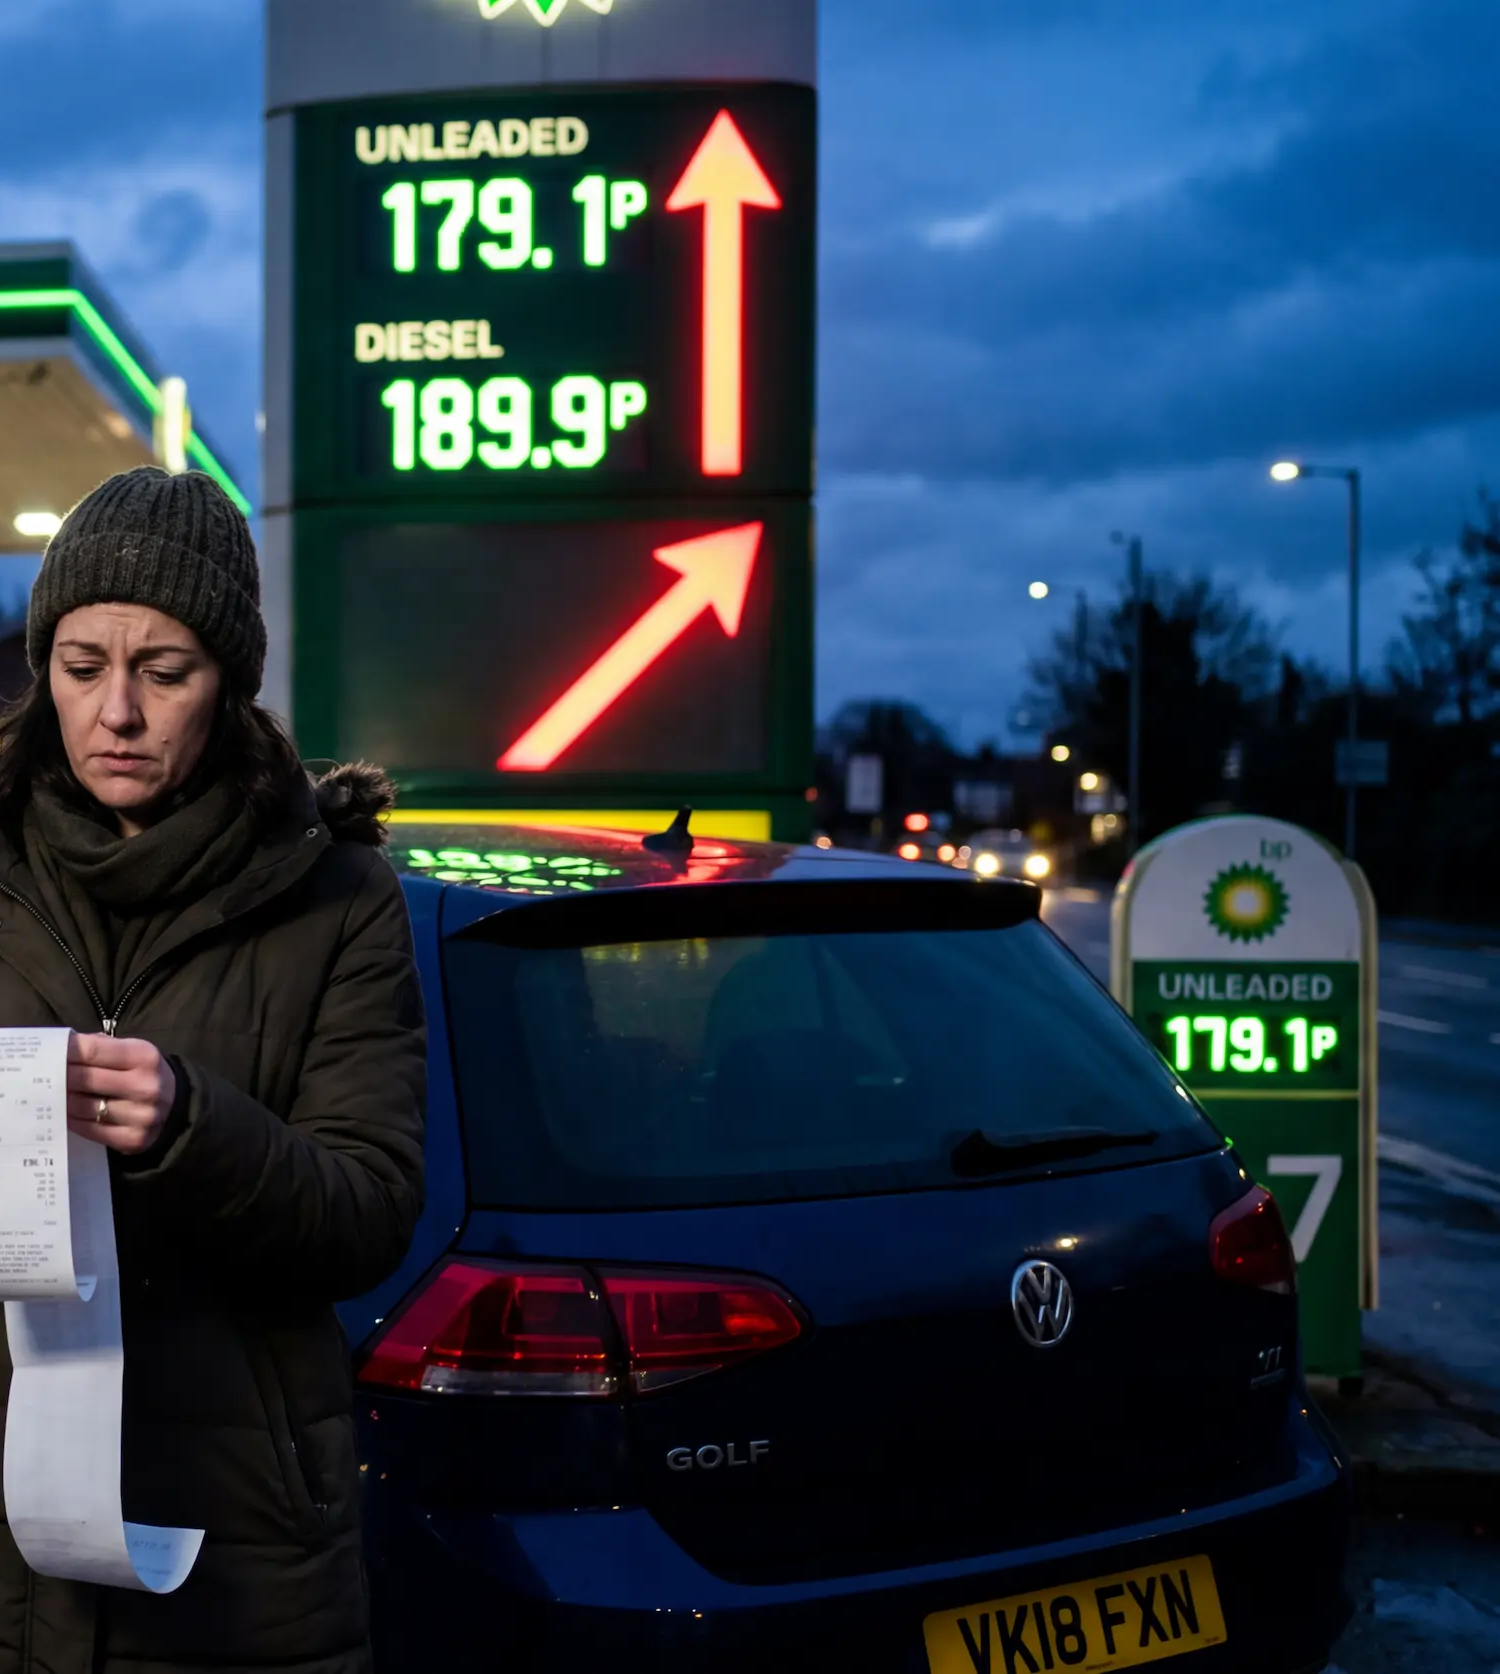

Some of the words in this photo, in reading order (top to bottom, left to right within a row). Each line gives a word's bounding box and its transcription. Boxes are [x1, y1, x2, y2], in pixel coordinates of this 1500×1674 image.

[355, 117, 589, 165] UNLEADED
[355, 319, 505, 363] DIESEL
[1259, 838, 1293, 862] bp
[1158, 972, 1333, 1001] UNLEADED
[666, 1439, 770, 1471] GOLF
[956, 1595, 1087, 1674] VK18
[1094, 1569, 1199, 1655] FXN
